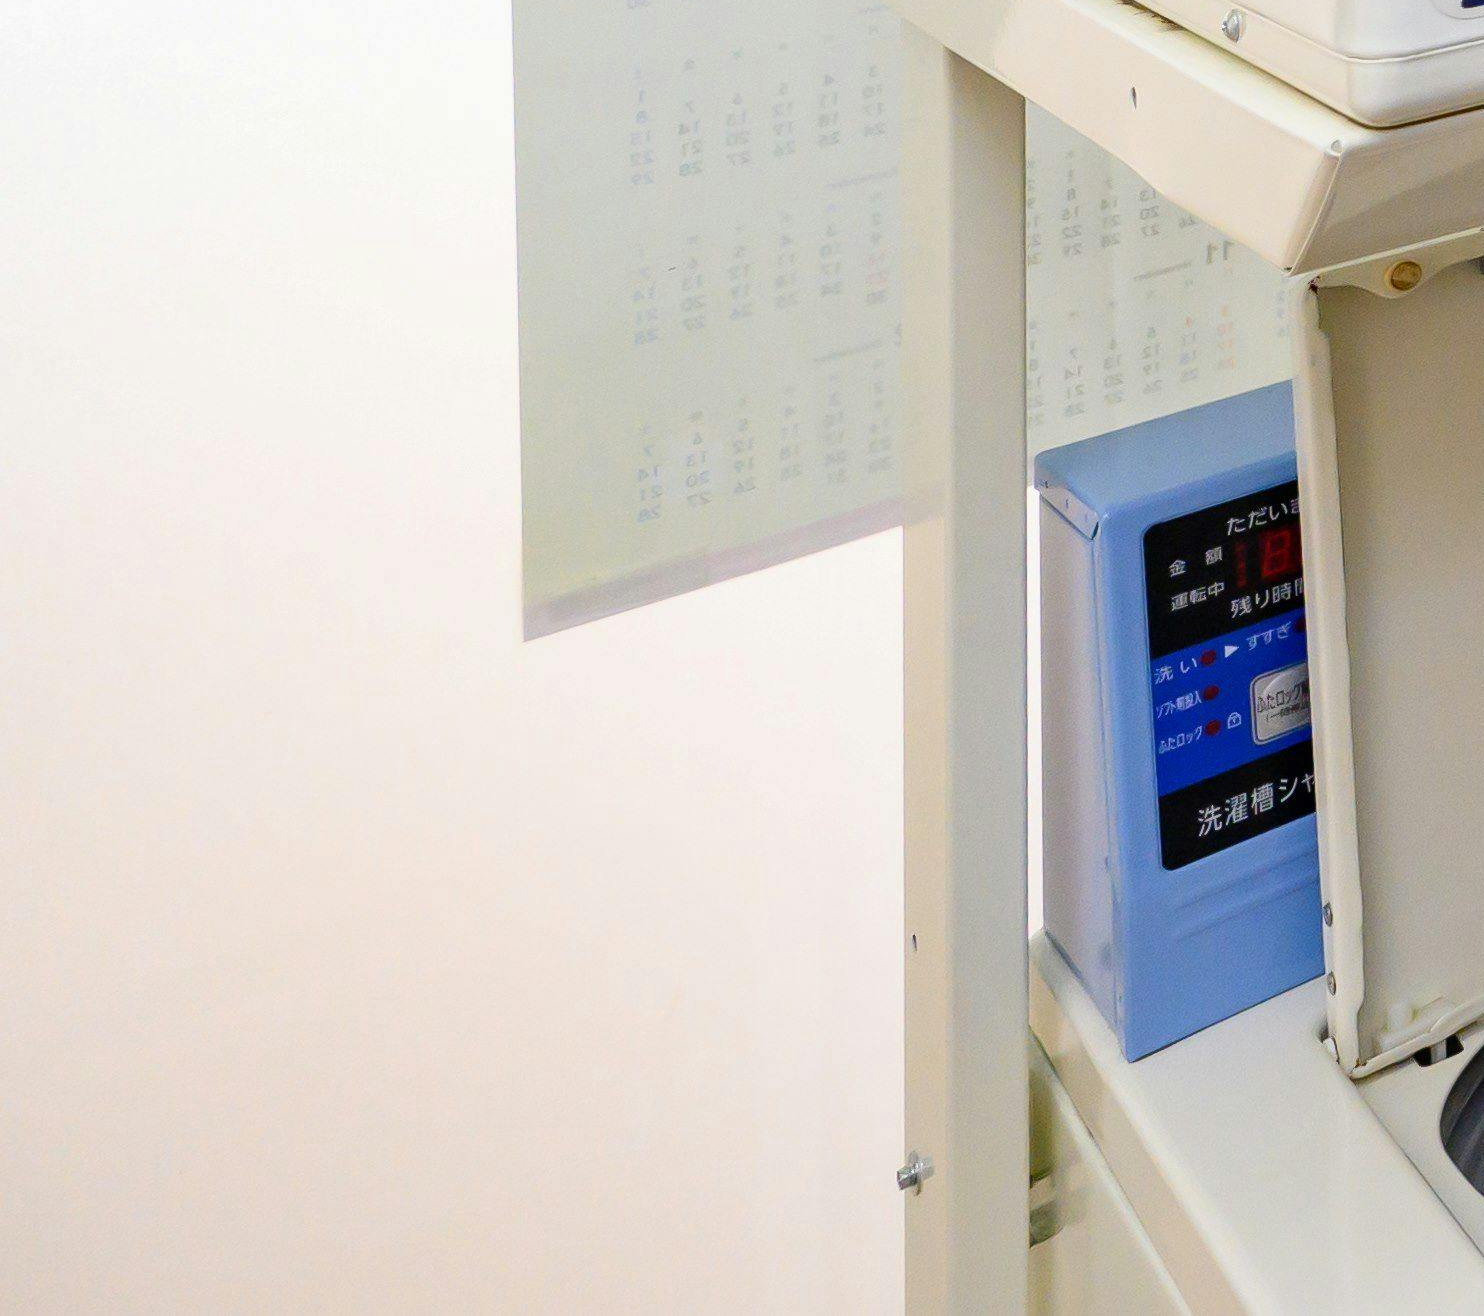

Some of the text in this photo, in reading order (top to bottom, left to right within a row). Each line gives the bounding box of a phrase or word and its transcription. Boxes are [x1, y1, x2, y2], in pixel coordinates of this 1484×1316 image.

[1171, 582, 1225, 612] 運転中
[1155, 620, 1292, 684] 洗い すすぎ
